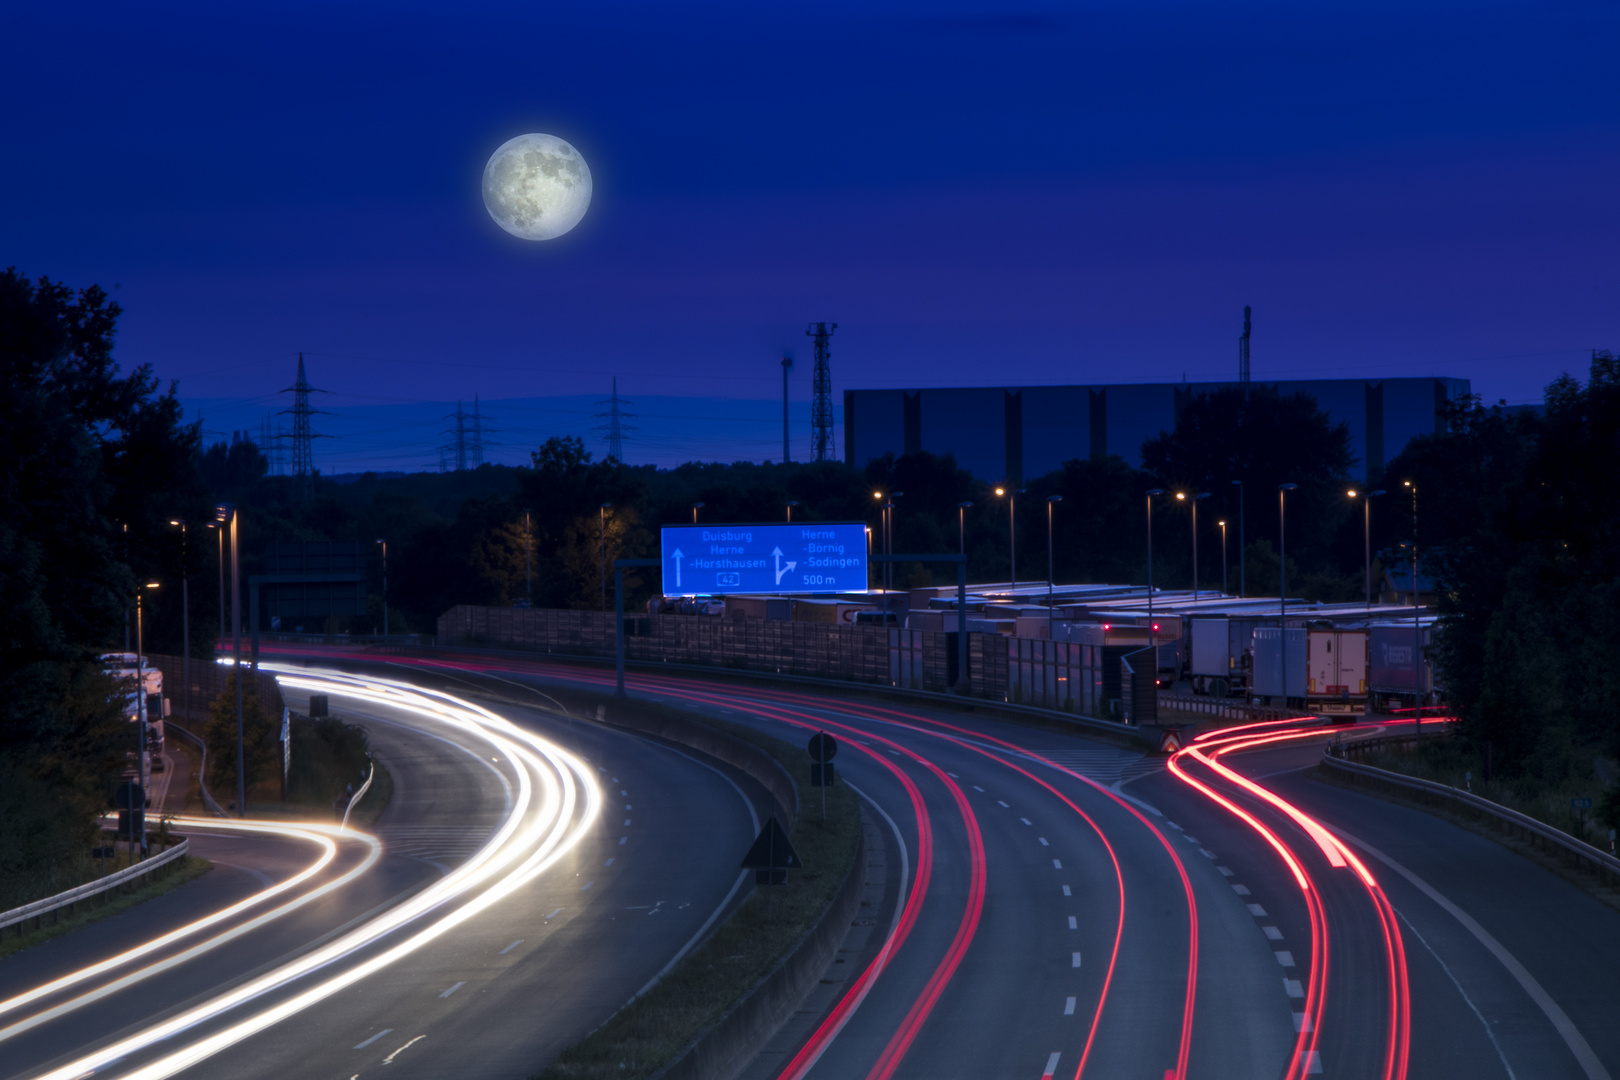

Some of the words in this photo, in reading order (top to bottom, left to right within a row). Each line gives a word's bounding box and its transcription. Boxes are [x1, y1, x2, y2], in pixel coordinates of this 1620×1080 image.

[702, 530, 752, 543] Duisburg
[802, 529, 836, 540] Herne
[710, 544, 745, 555] Herne
[802, 542, 845, 555] -Börnig
[689, 558, 766, 569] -Horsthausen
[802, 556, 860, 569] -Sodingen
[722, 574, 734, 584] 42
[803, 574, 823, 585] 500
[825, 576, 836, 585] m
